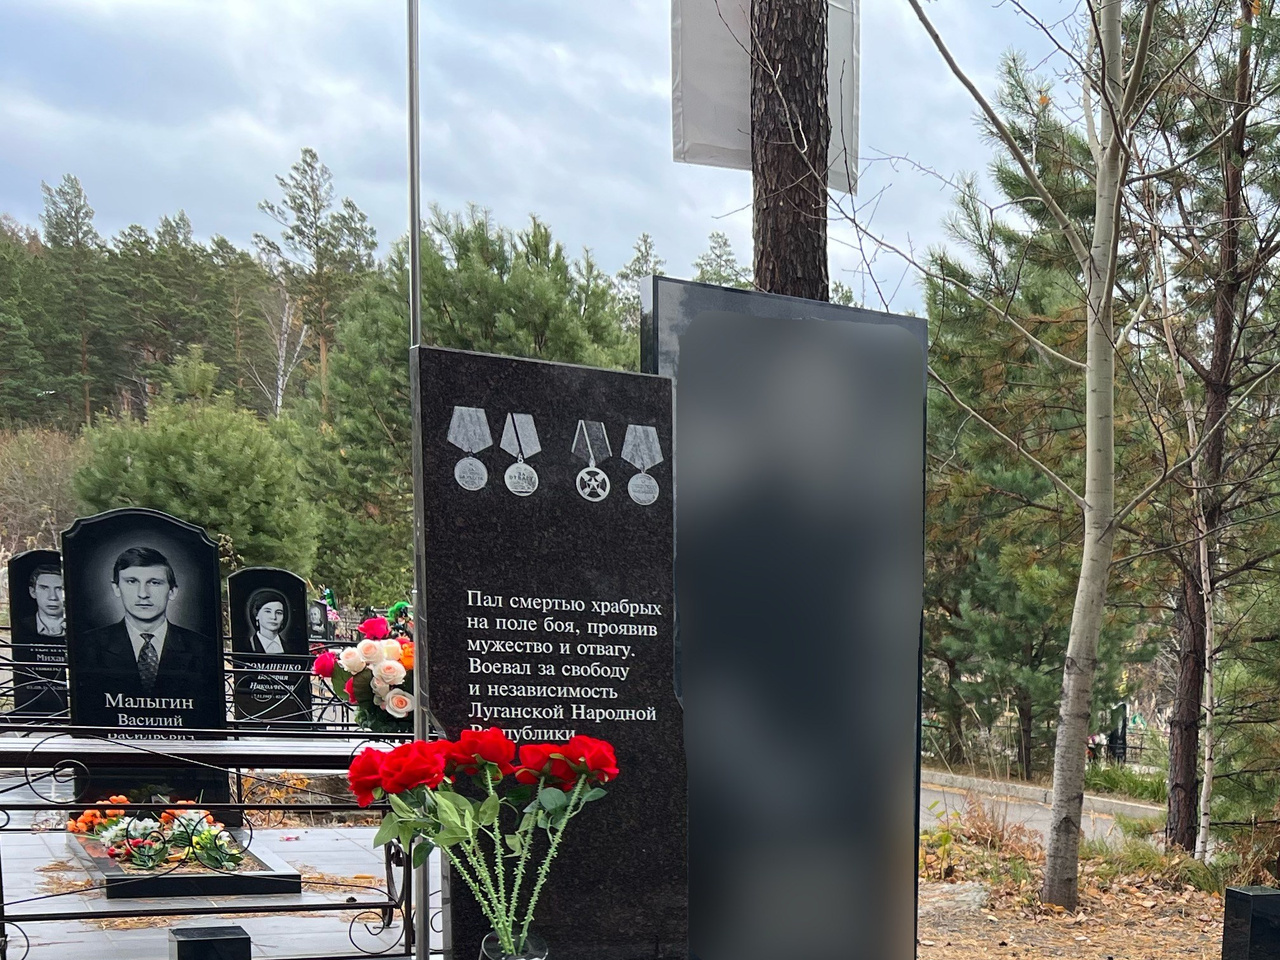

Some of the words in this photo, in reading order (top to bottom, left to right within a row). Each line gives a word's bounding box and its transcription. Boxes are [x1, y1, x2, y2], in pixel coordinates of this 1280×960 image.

[466, 590, 503, 608] Пал
[509, 595, 586, 613] смертью
[590, 599, 662, 617] храбрых
[466, 616, 489, 630] на
[495, 618, 538, 632] поле
[543, 616, 581, 636] боя,
[586, 621, 659, 638] проявив
[466, 639, 553, 655] мужество
[558, 642, 571, 655] и
[576, 643, 636, 660] отвагу.
[468, 657, 532, 675] Воевал
[537, 662, 556, 676] за
[561, 661, 630, 681] свободу
[104, 692, 194, 710] Малыгин
[468, 683, 481, 696] и
[487, 683, 618, 699] независимость
[117, 713, 184, 727] Василий
[467, 702, 565, 721] Луганской
[570, 703, 657, 724] Народной
[469, 723, 576, 744] Рпублики
